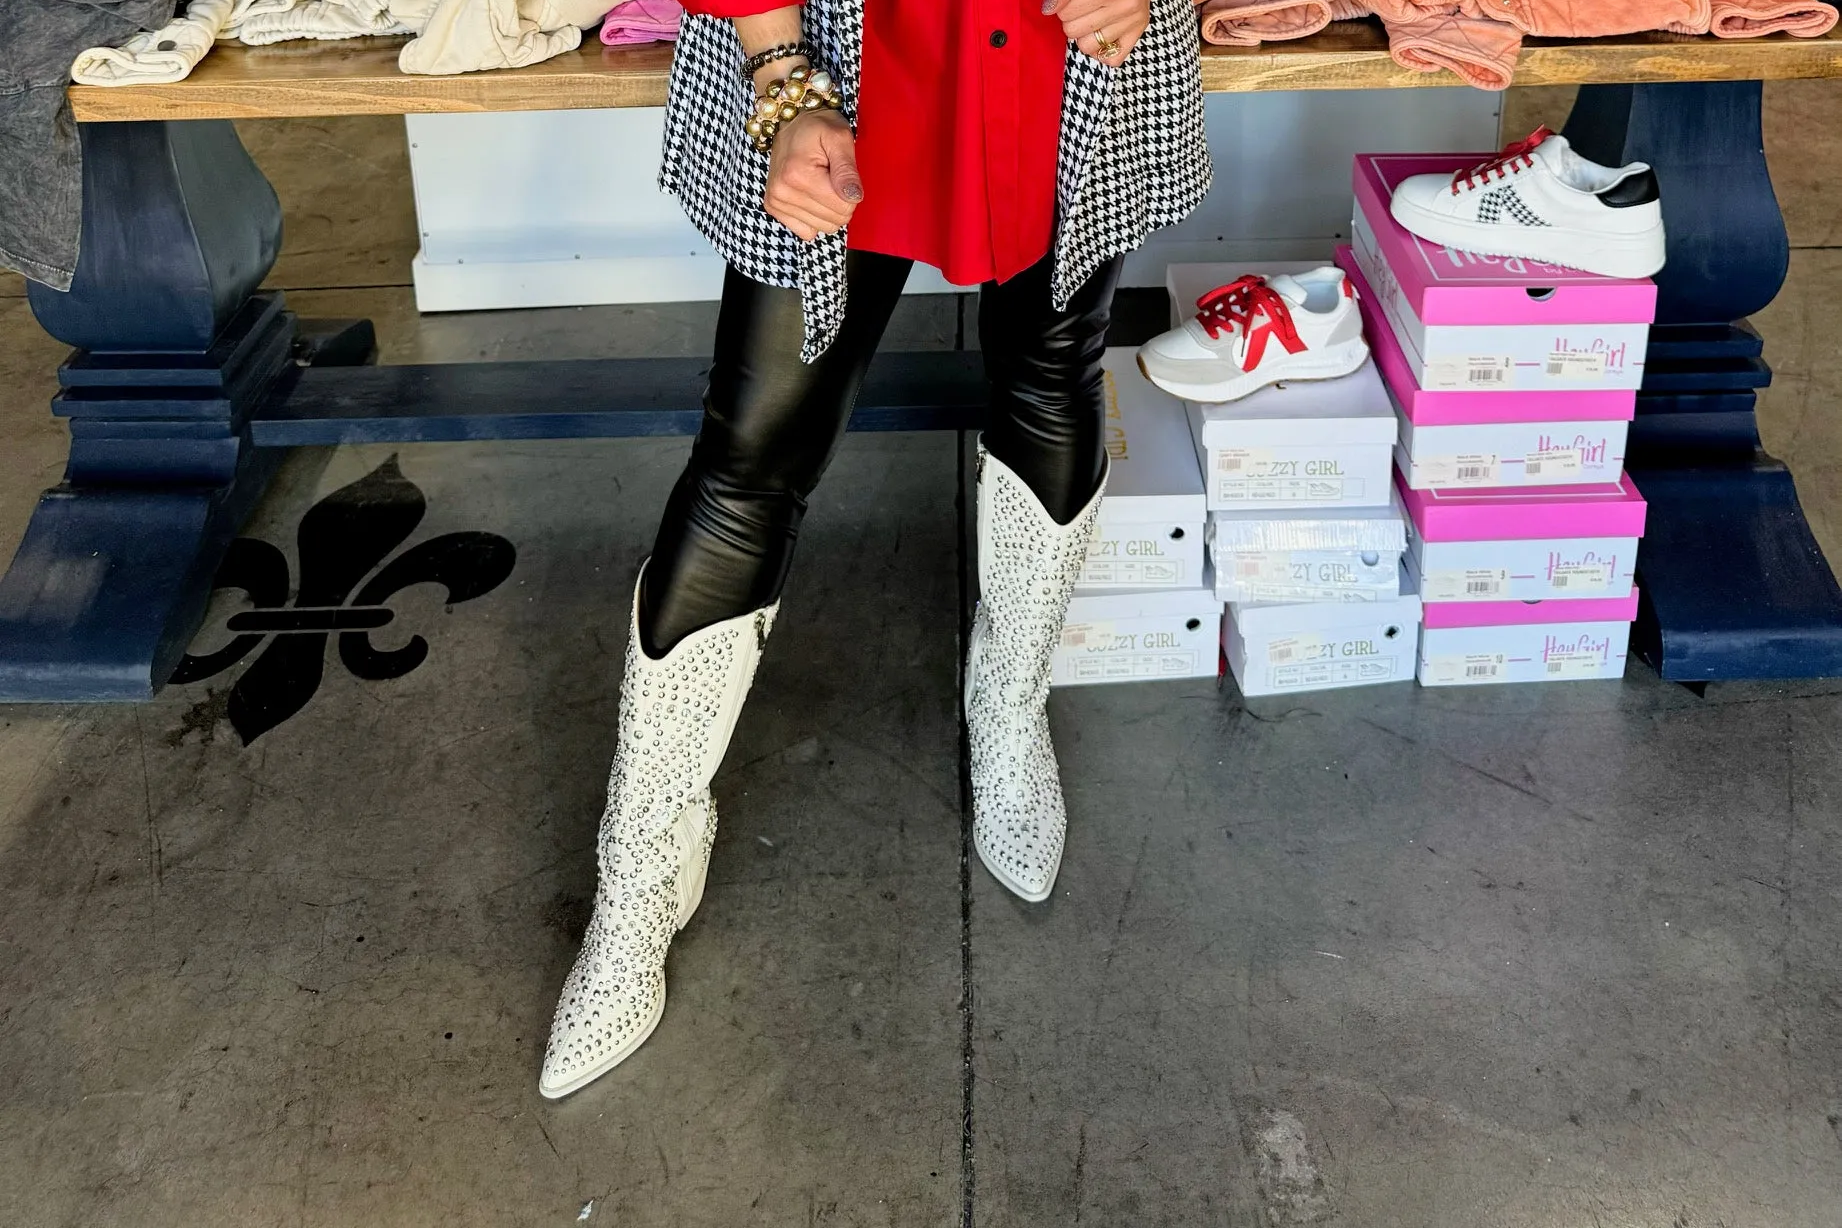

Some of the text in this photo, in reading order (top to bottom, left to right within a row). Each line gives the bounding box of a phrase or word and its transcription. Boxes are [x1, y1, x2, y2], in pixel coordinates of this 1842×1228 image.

[1246, 460, 1345, 478] ZZY GIRL
[1126, 540, 1165, 556] GIRL
[1319, 563, 1359, 583] GIRL
[1143, 632, 1181, 648] GIRL
[1342, 639, 1380, 657] GIRL
